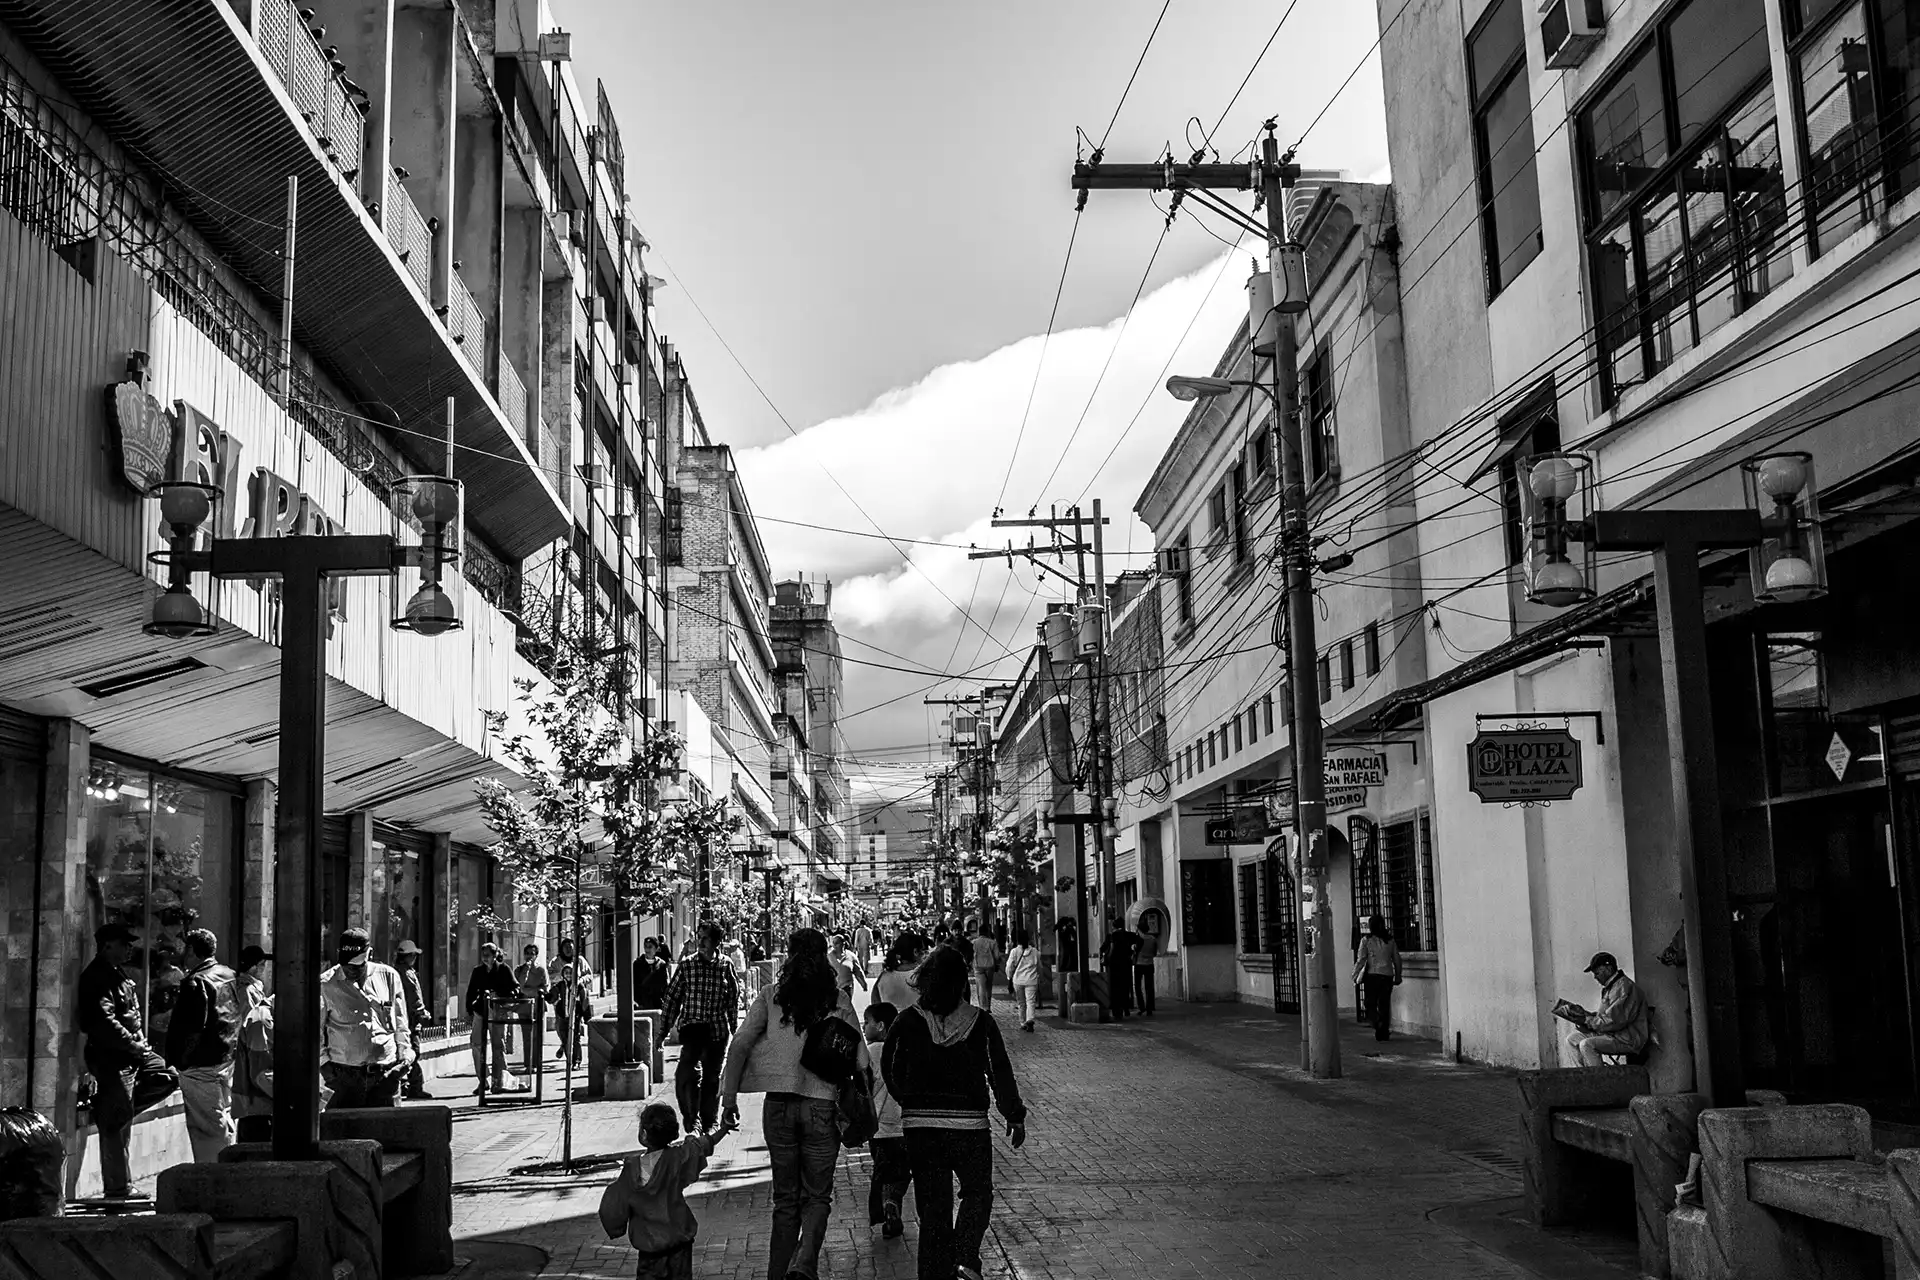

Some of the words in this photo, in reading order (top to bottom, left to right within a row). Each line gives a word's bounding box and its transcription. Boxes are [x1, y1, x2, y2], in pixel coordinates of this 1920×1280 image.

[1505, 742, 1572, 760] HOTEL
[1322, 757, 1381, 771] FARMACIA
[1504, 759, 1570, 776] PLAZA
[1344, 772, 1382, 785] RAFAEL
